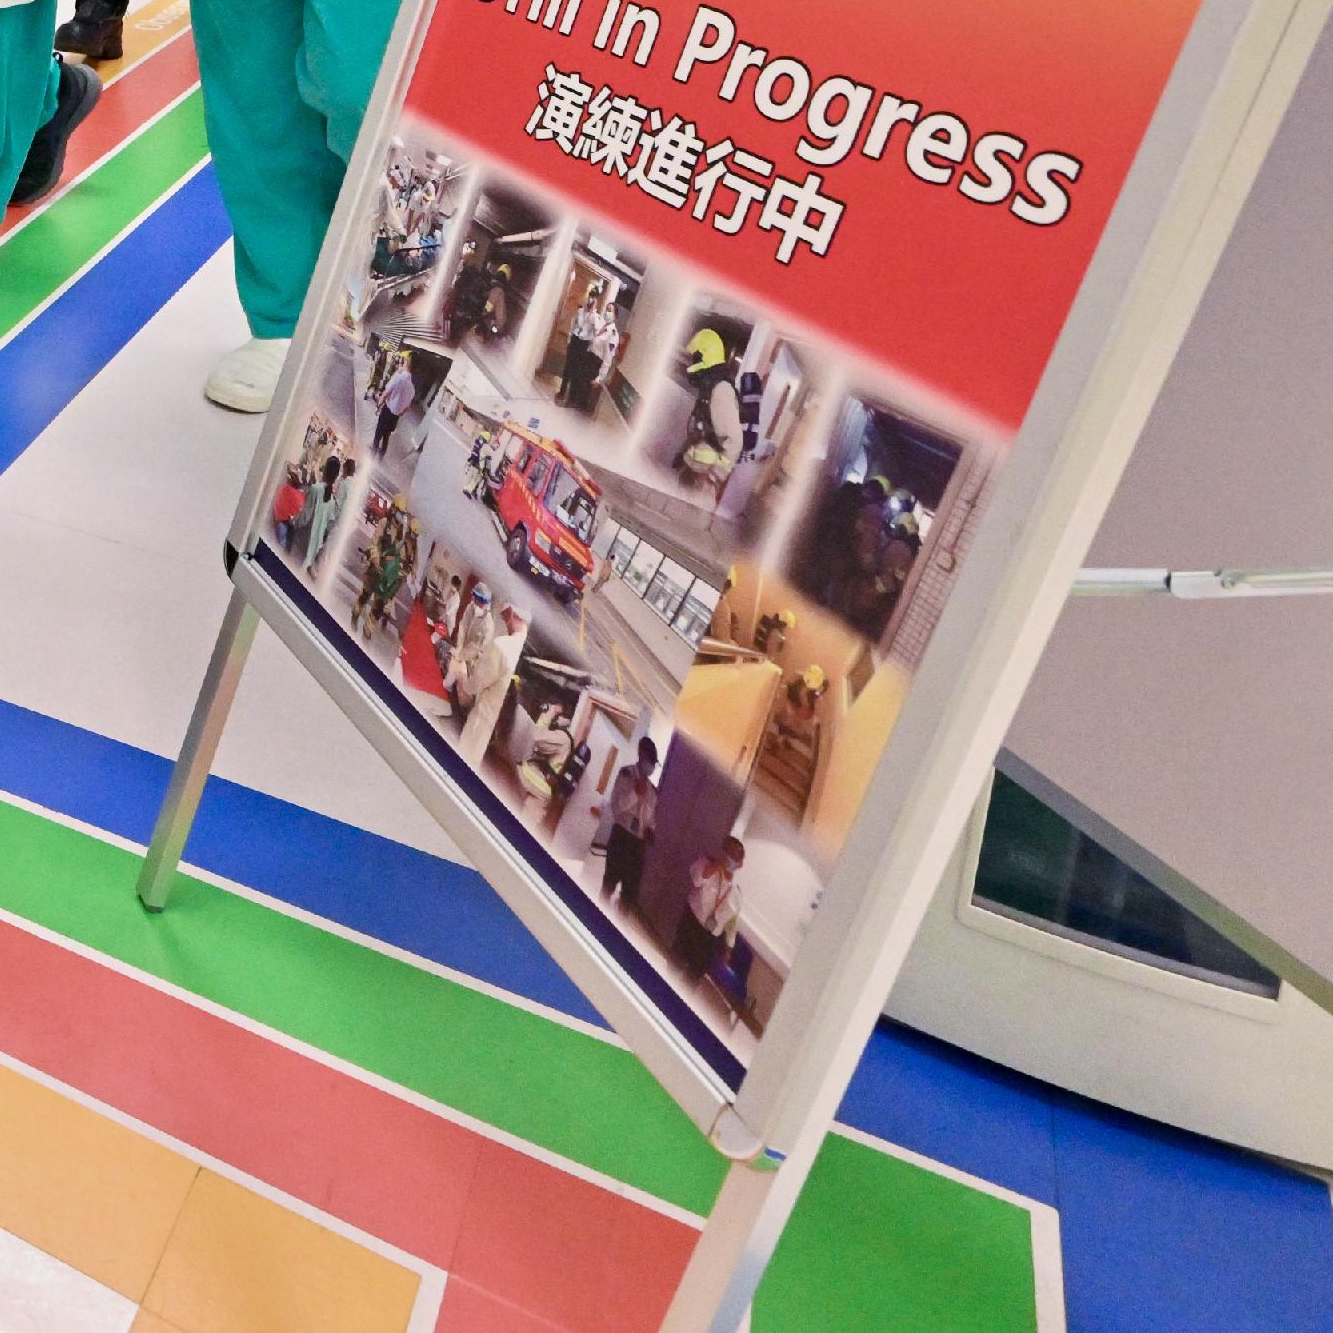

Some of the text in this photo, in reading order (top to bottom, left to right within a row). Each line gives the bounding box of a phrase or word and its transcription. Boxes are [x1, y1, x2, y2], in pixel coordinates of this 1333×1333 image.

[524, 62, 848, 267] 演練進行中
[673, 4, 1082, 227] Progress
